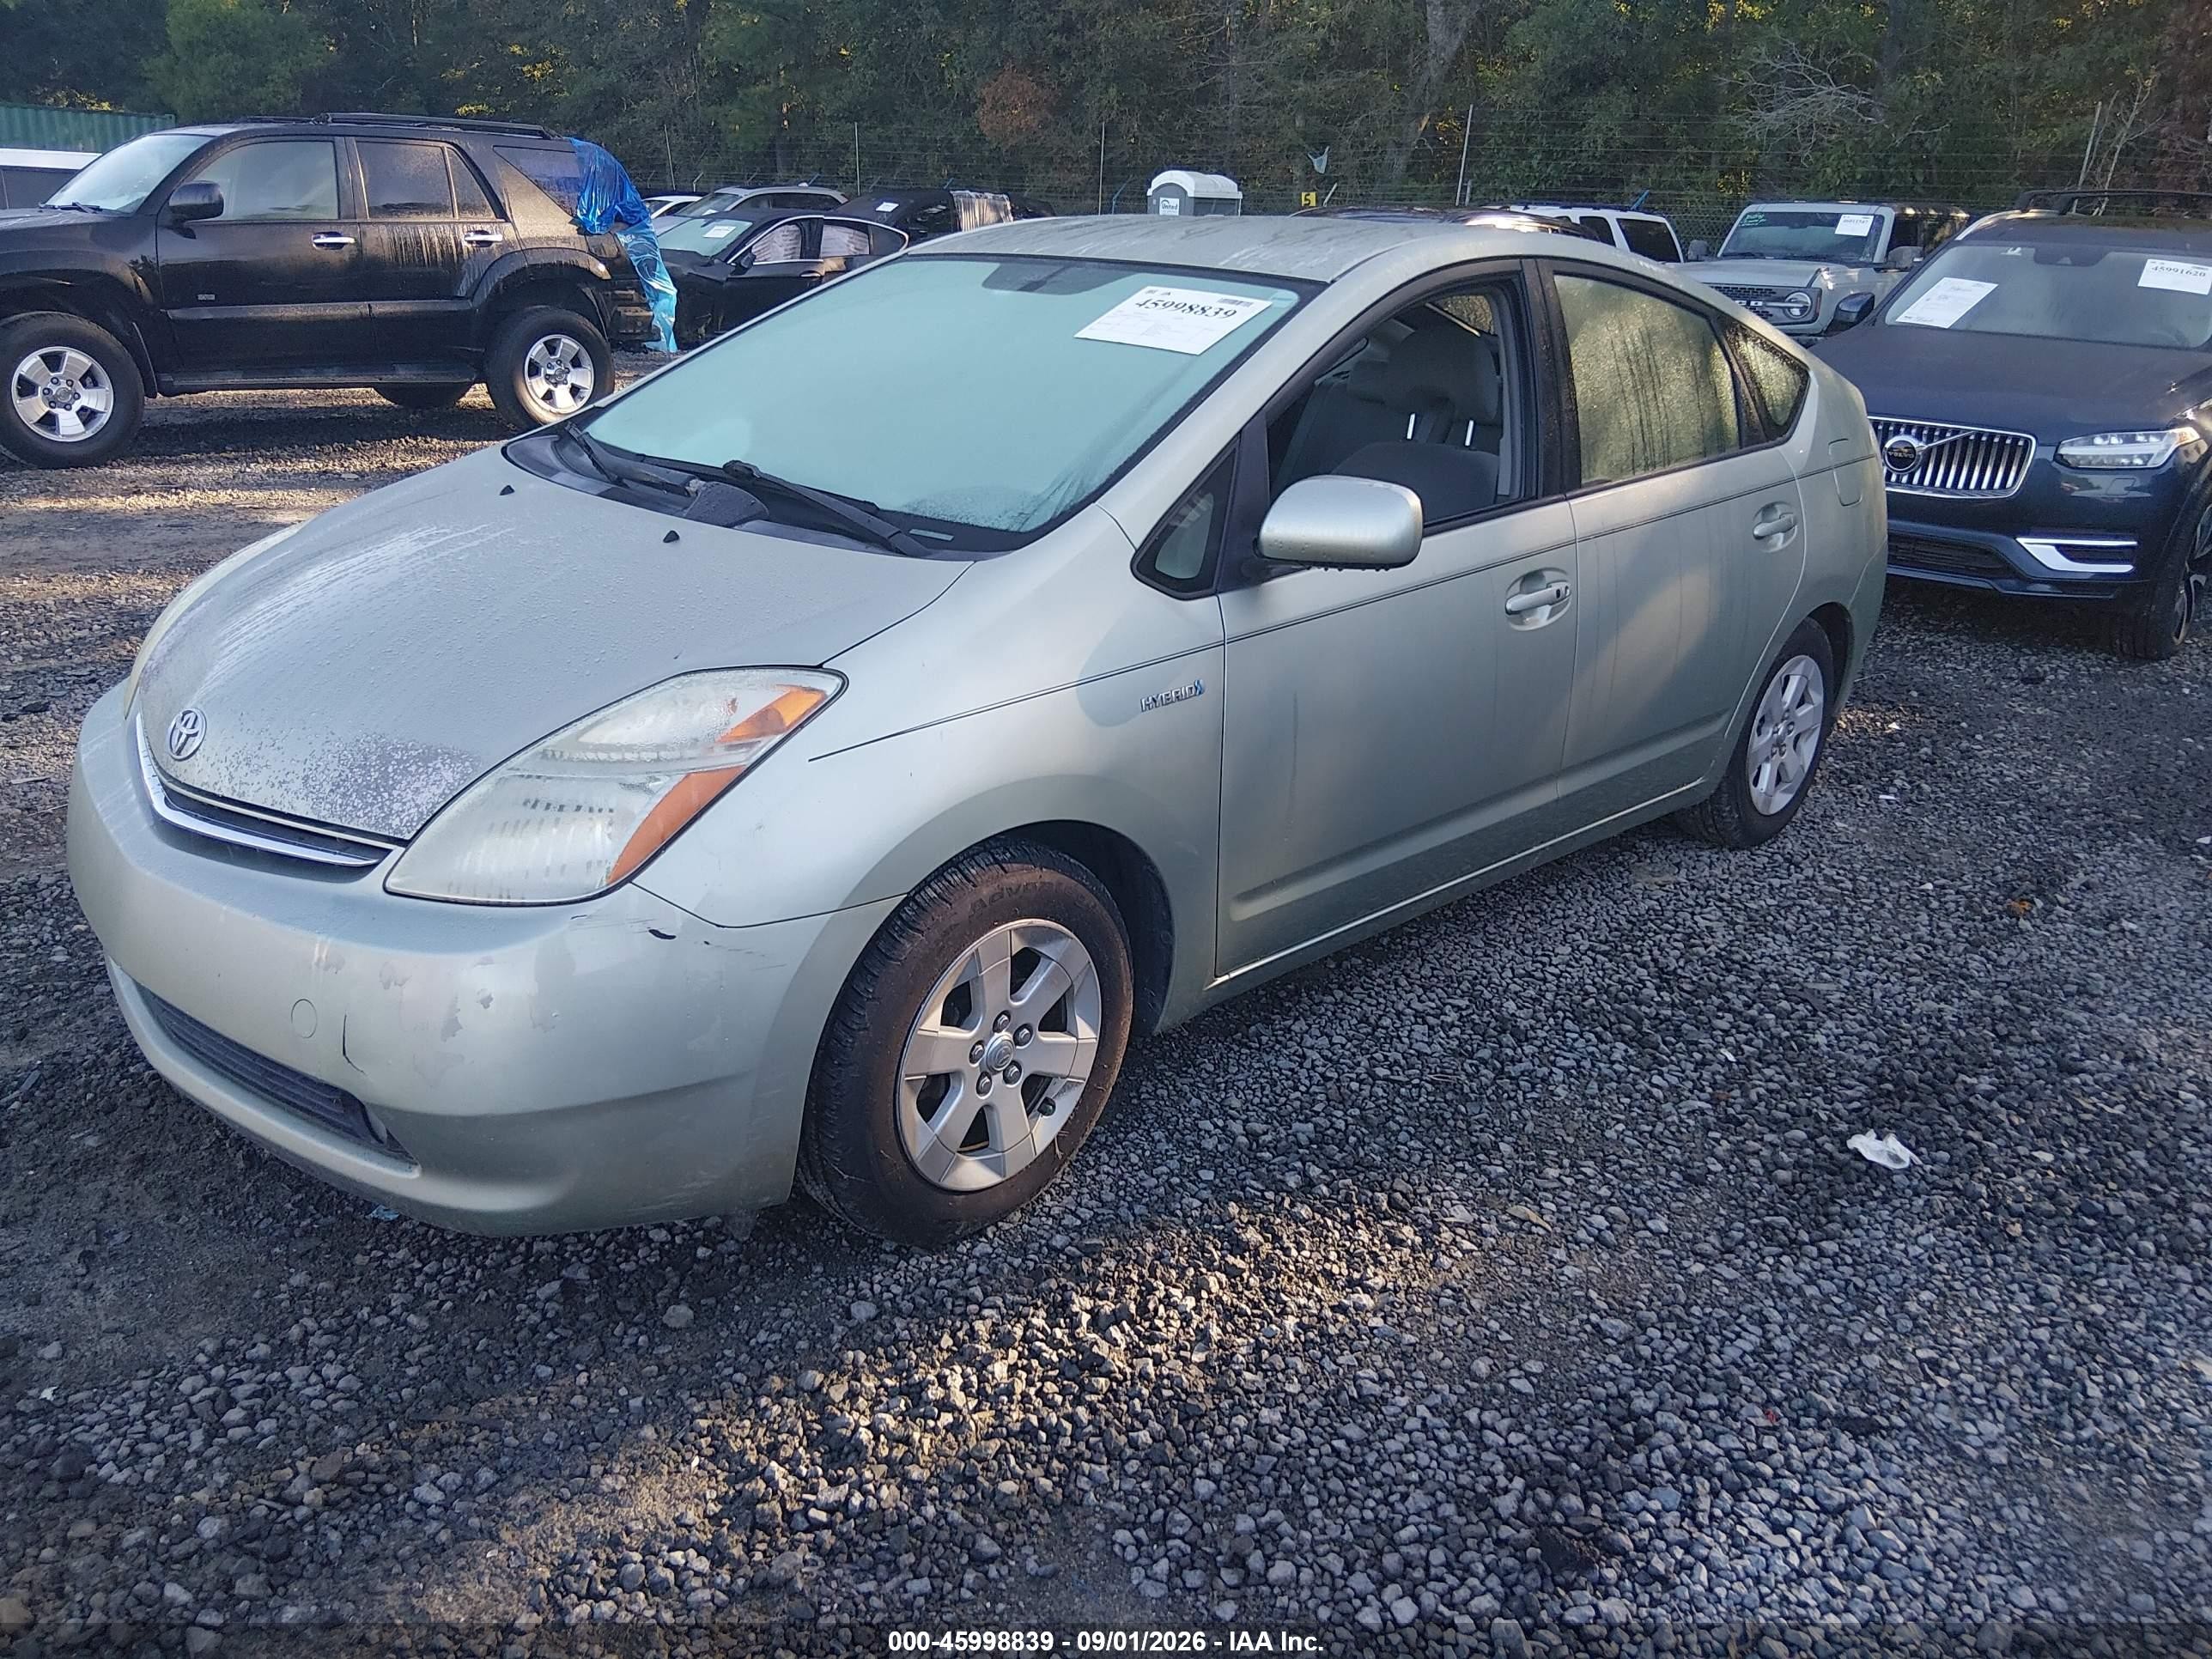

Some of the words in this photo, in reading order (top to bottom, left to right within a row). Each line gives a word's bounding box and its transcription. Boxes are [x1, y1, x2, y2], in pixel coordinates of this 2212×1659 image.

[1304, 193, 1310, 206] 5
[2151, 265, 2207, 277] 45991620
[1134, 298, 1237, 319] 45998839
[1140, 684, 1195, 712] HYBRID
